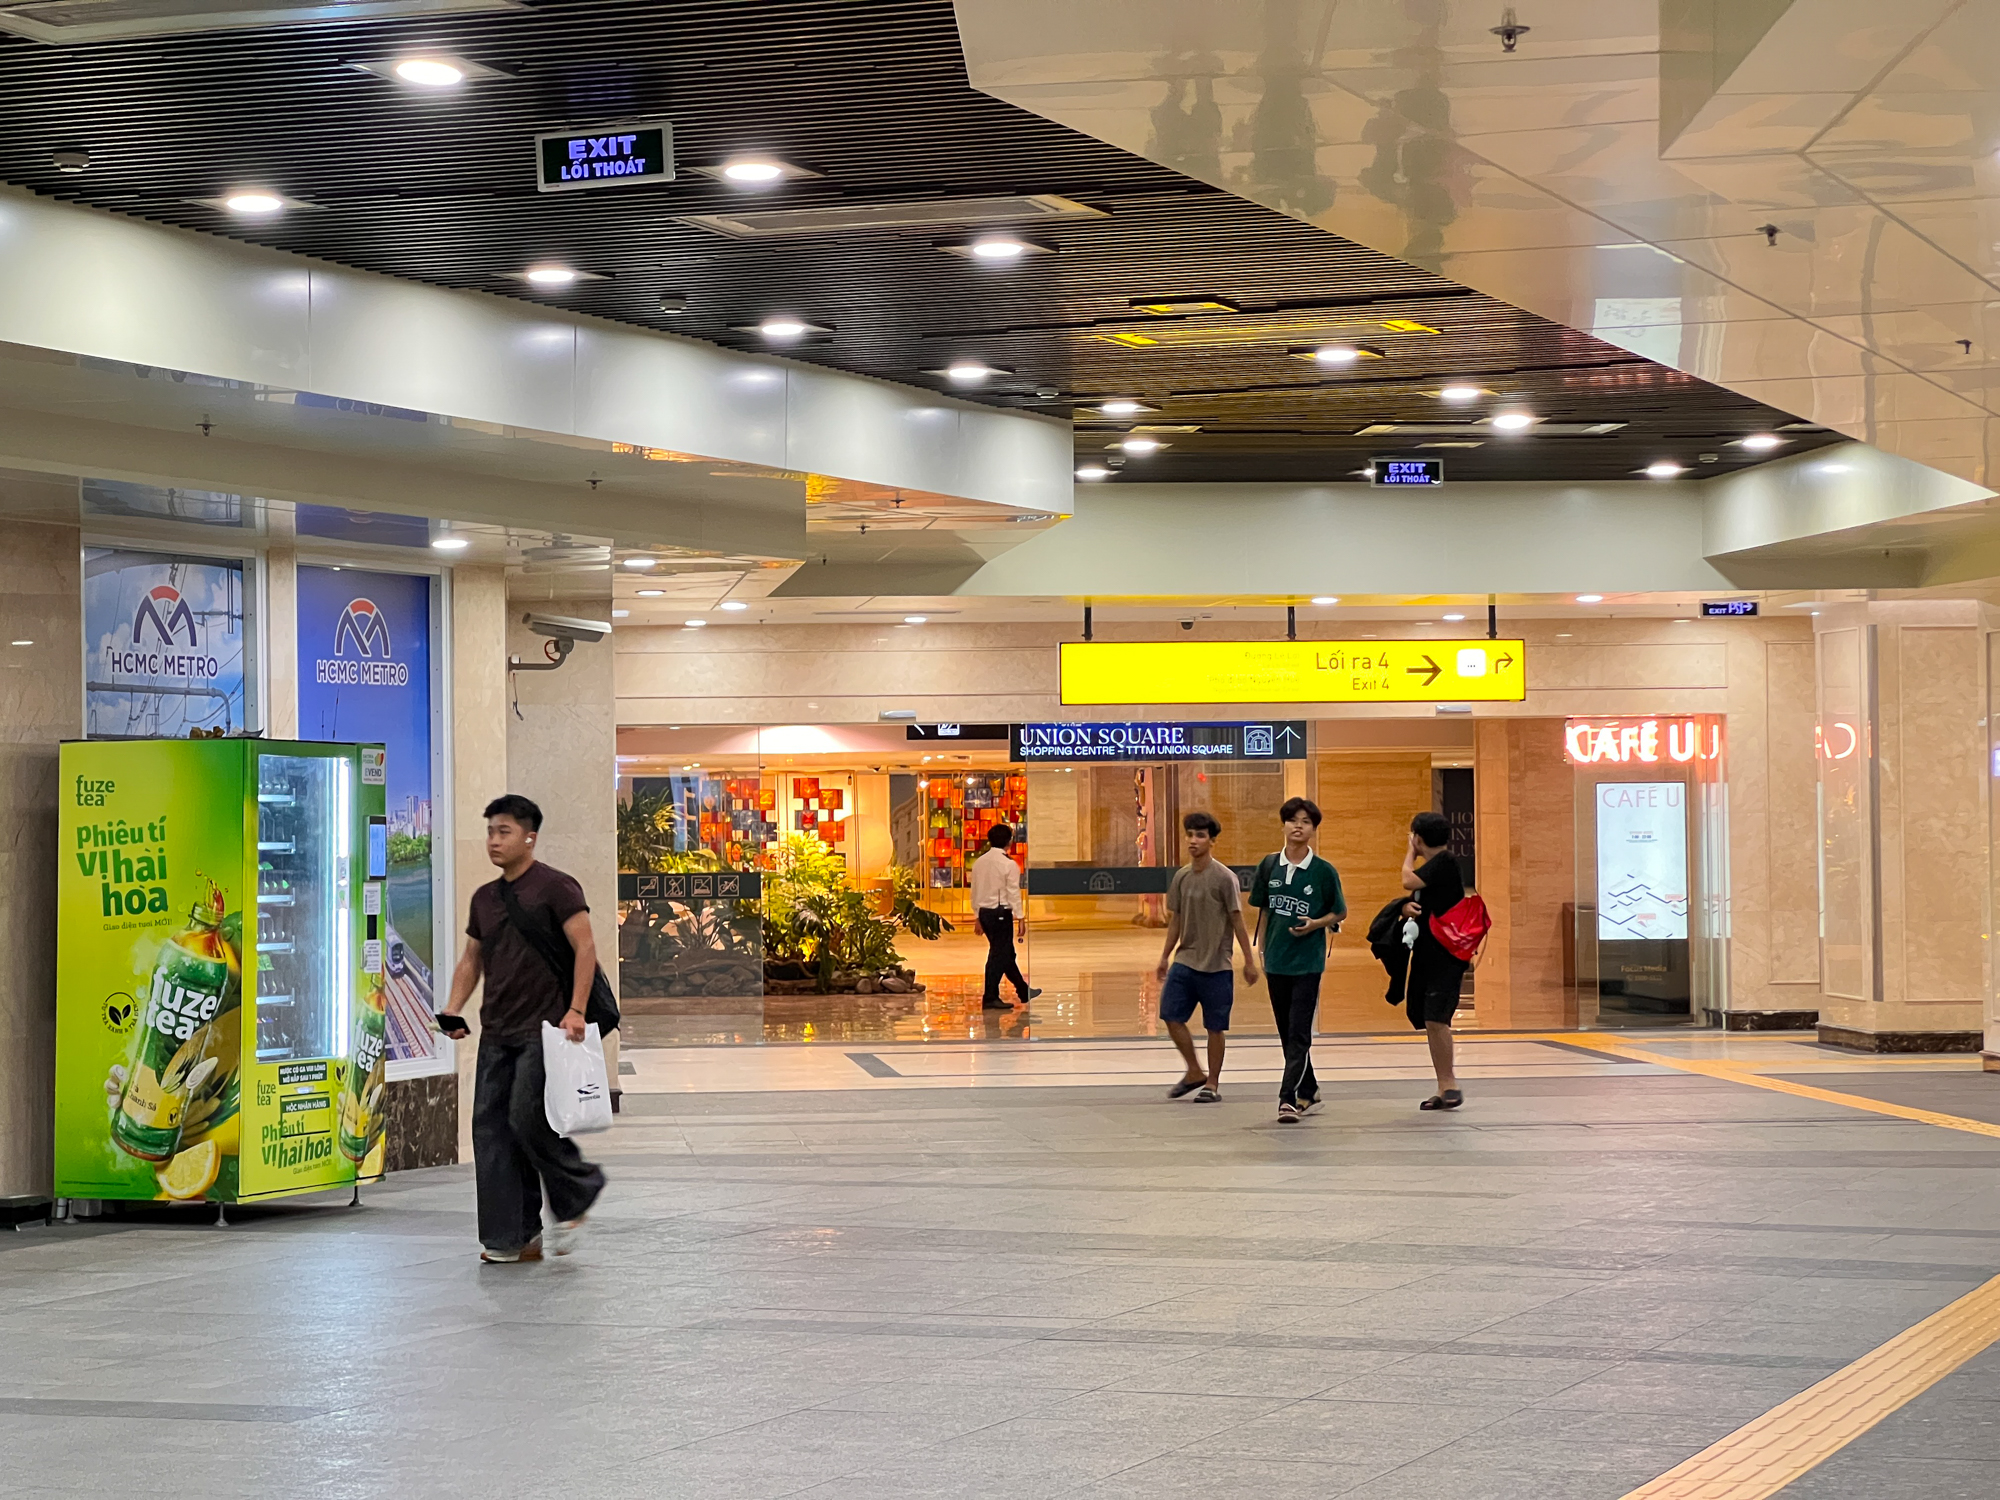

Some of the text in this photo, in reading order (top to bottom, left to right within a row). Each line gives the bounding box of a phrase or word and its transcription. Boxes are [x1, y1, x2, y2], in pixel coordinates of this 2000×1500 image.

[568, 135, 637, 159] EXIT
[561, 156, 646, 180] LỐI THOÁT
[1388, 463, 1427, 473] EXIT
[1401, 473, 1431, 483] THOÁT
[111, 651, 218, 677] HCMC METRO
[1316, 650, 1389, 670] Lối ra 4
[317, 660, 408, 686] HCMC METRO
[1352, 678, 1389, 691] Exit 4
[1020, 727, 1184, 748] UNION SQUARE
[1568, 720, 1659, 763] CAFÉ
[1669, 721, 1695, 762] U
[1020, 746, 1072, 756] SHOPPING
[1074, 745, 1115, 756] CENTRE
[1126, 745, 1156, 755] TTTM
[1157, 745, 1190, 755] UNION
[1192, 744, 1233, 755] SQUARE
[76, 774, 115, 794] fuze
[76, 793, 105, 806] tea
[1602, 786, 1680, 808] CAFÉ U
[147, 815, 167, 842] tí
[112, 847, 167, 883] hài
[102, 883, 168, 917] hòa
[151, 966, 218, 1021] fuze
[146, 1000, 195, 1041] tea
[257, 1079, 276, 1096] fuze
[257, 1095, 271, 1106] tea
[304, 1136, 333, 1162] hòa
